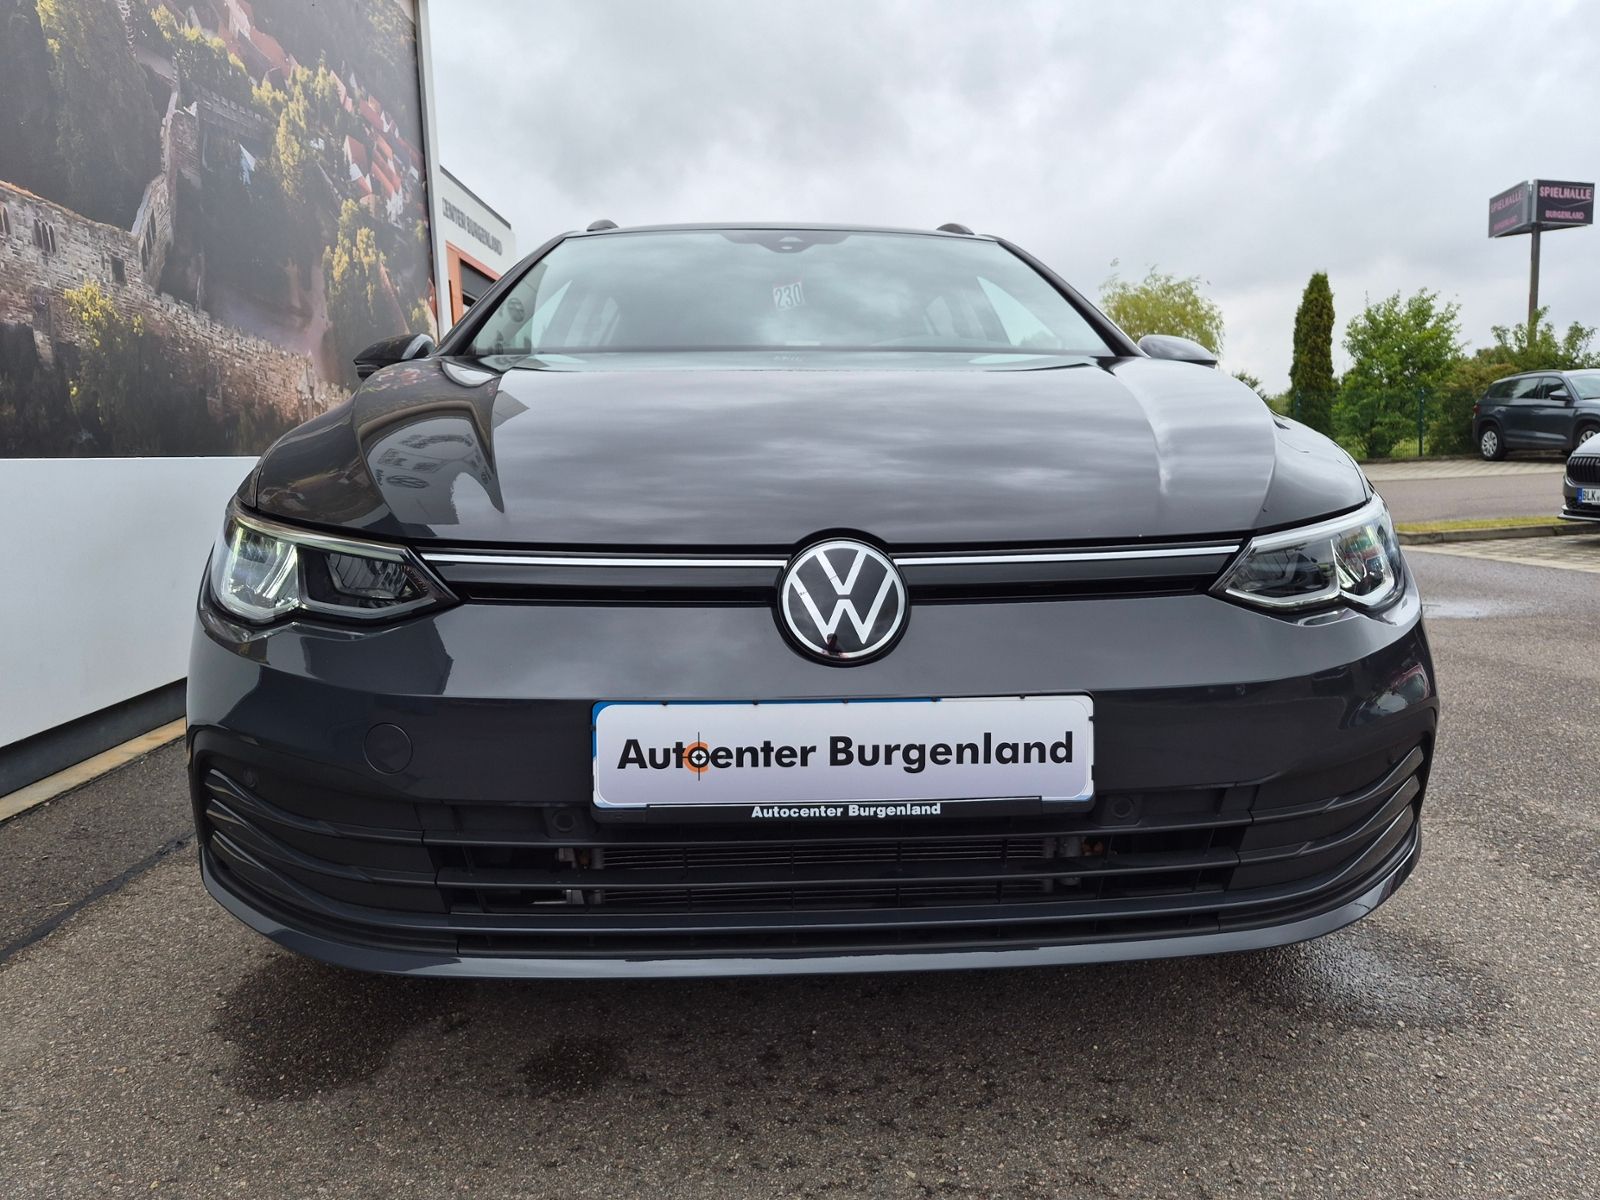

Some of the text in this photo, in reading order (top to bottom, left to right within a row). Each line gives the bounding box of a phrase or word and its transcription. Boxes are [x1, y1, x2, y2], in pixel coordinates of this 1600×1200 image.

[1539, 186, 1592, 200] SPIELHALLE
[775, 284, 801, 309] 230
[829, 732, 1074, 774] Burgenland
[752, 802, 942, 819] Autocenter Burgenland
